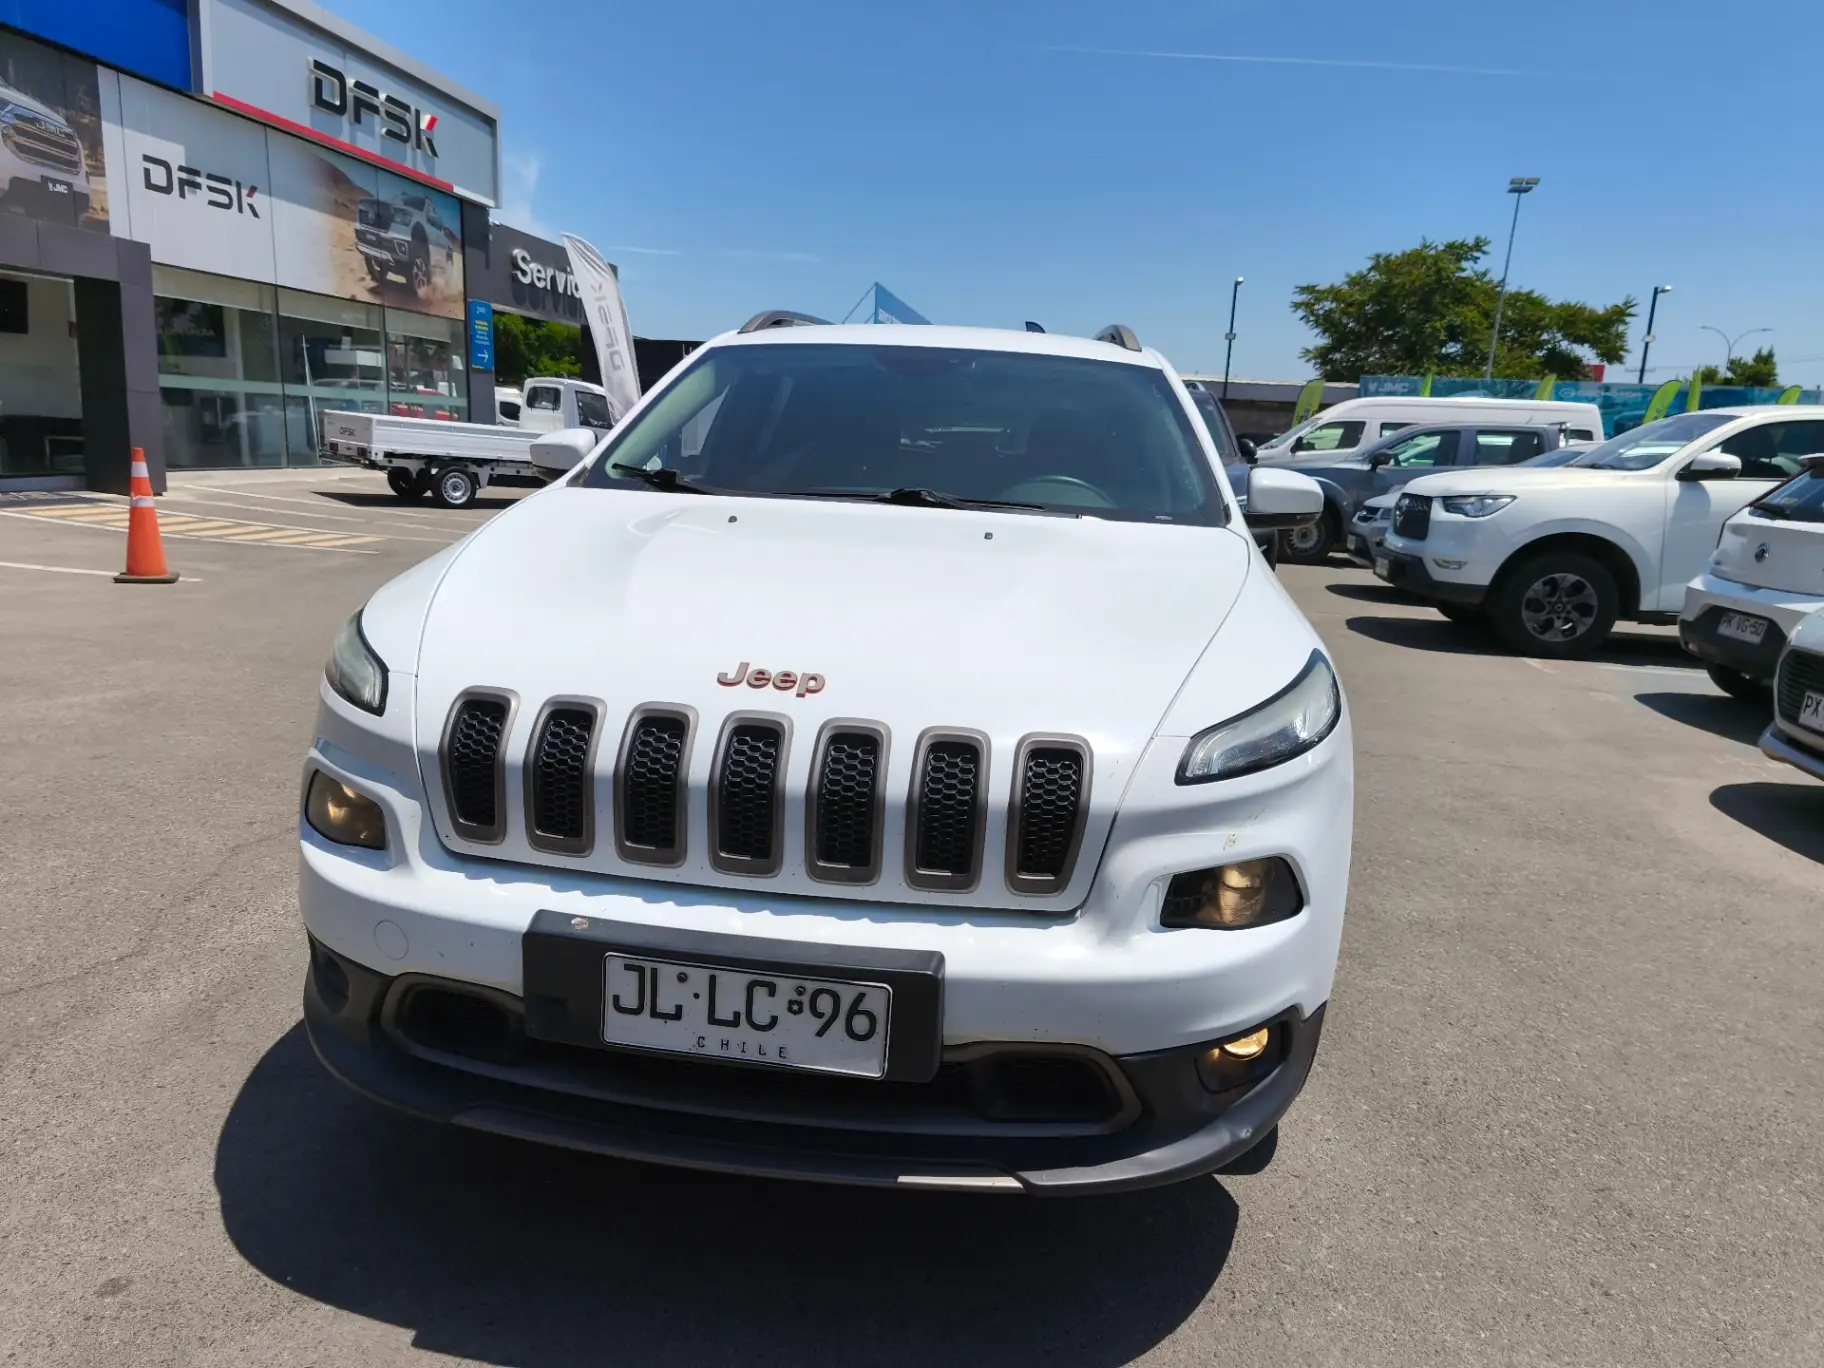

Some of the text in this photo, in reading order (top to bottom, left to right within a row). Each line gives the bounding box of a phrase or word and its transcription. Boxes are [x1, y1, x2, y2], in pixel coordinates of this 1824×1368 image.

[308, 57, 439, 159] DFSK
[142, 153, 260, 219] DFSK
[717, 661, 825, 698] Jeep
